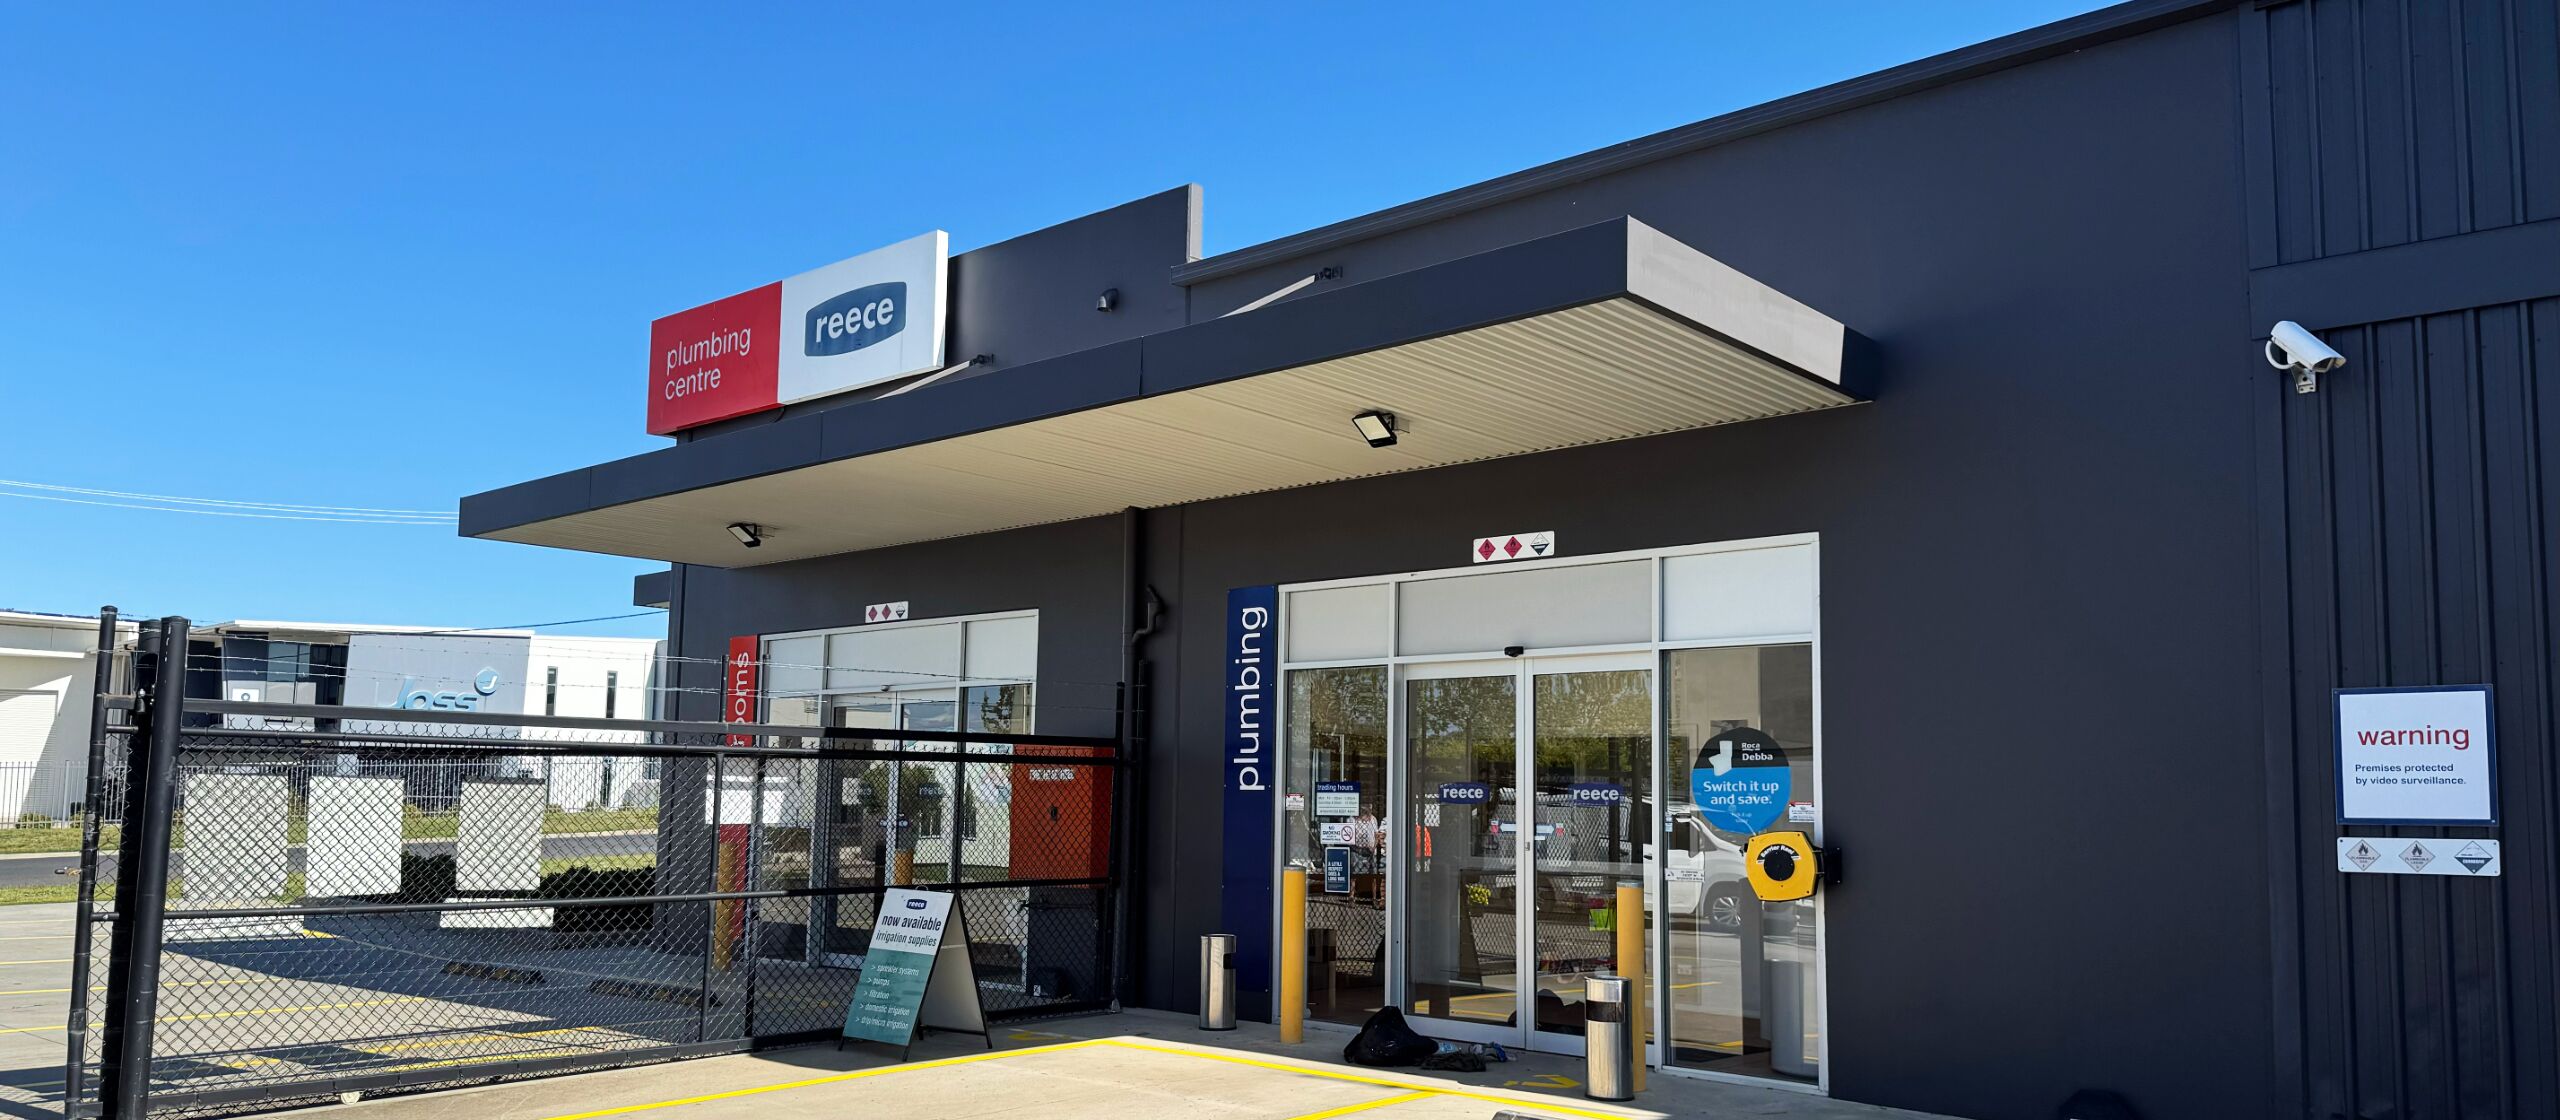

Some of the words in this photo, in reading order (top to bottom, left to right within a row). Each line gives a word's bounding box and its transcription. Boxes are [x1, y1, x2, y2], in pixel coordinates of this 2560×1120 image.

[815, 297, 894, 343] reece
[667, 327, 751, 376] plumbing
[665, 368, 721, 400] centre
[1233, 606, 1268, 791] plumbing
[2357, 724, 2470, 750] warning
[1742, 753, 1773, 761] Debba
[2355, 764, 2401, 772] Premises
[2404, 763, 2454, 774] protected
[1317, 783, 1336, 791] trading
[1703, 780, 1747, 792] Switch
[1750, 780, 1760, 792] it
[1762, 782, 1779, 794] up
[2355, 776, 2367, 786] by
[2370, 776, 2398, 785] video
[2401, 776, 2467, 785] surveillance.
[1442, 786, 1484, 800] reece
[1573, 787, 1619, 801] reece
[1710, 793, 1735, 805] and
[1737, 795, 1773, 805] save.
[908, 900, 925, 908] reece
[882, 915, 899, 927] now
[901, 915, 942, 932] available
[876, 930, 907, 944] irrigation
[908, 934, 937, 948] supplies
[899, 968, 920, 976] systems
[872, 977, 890, 986] pumps
